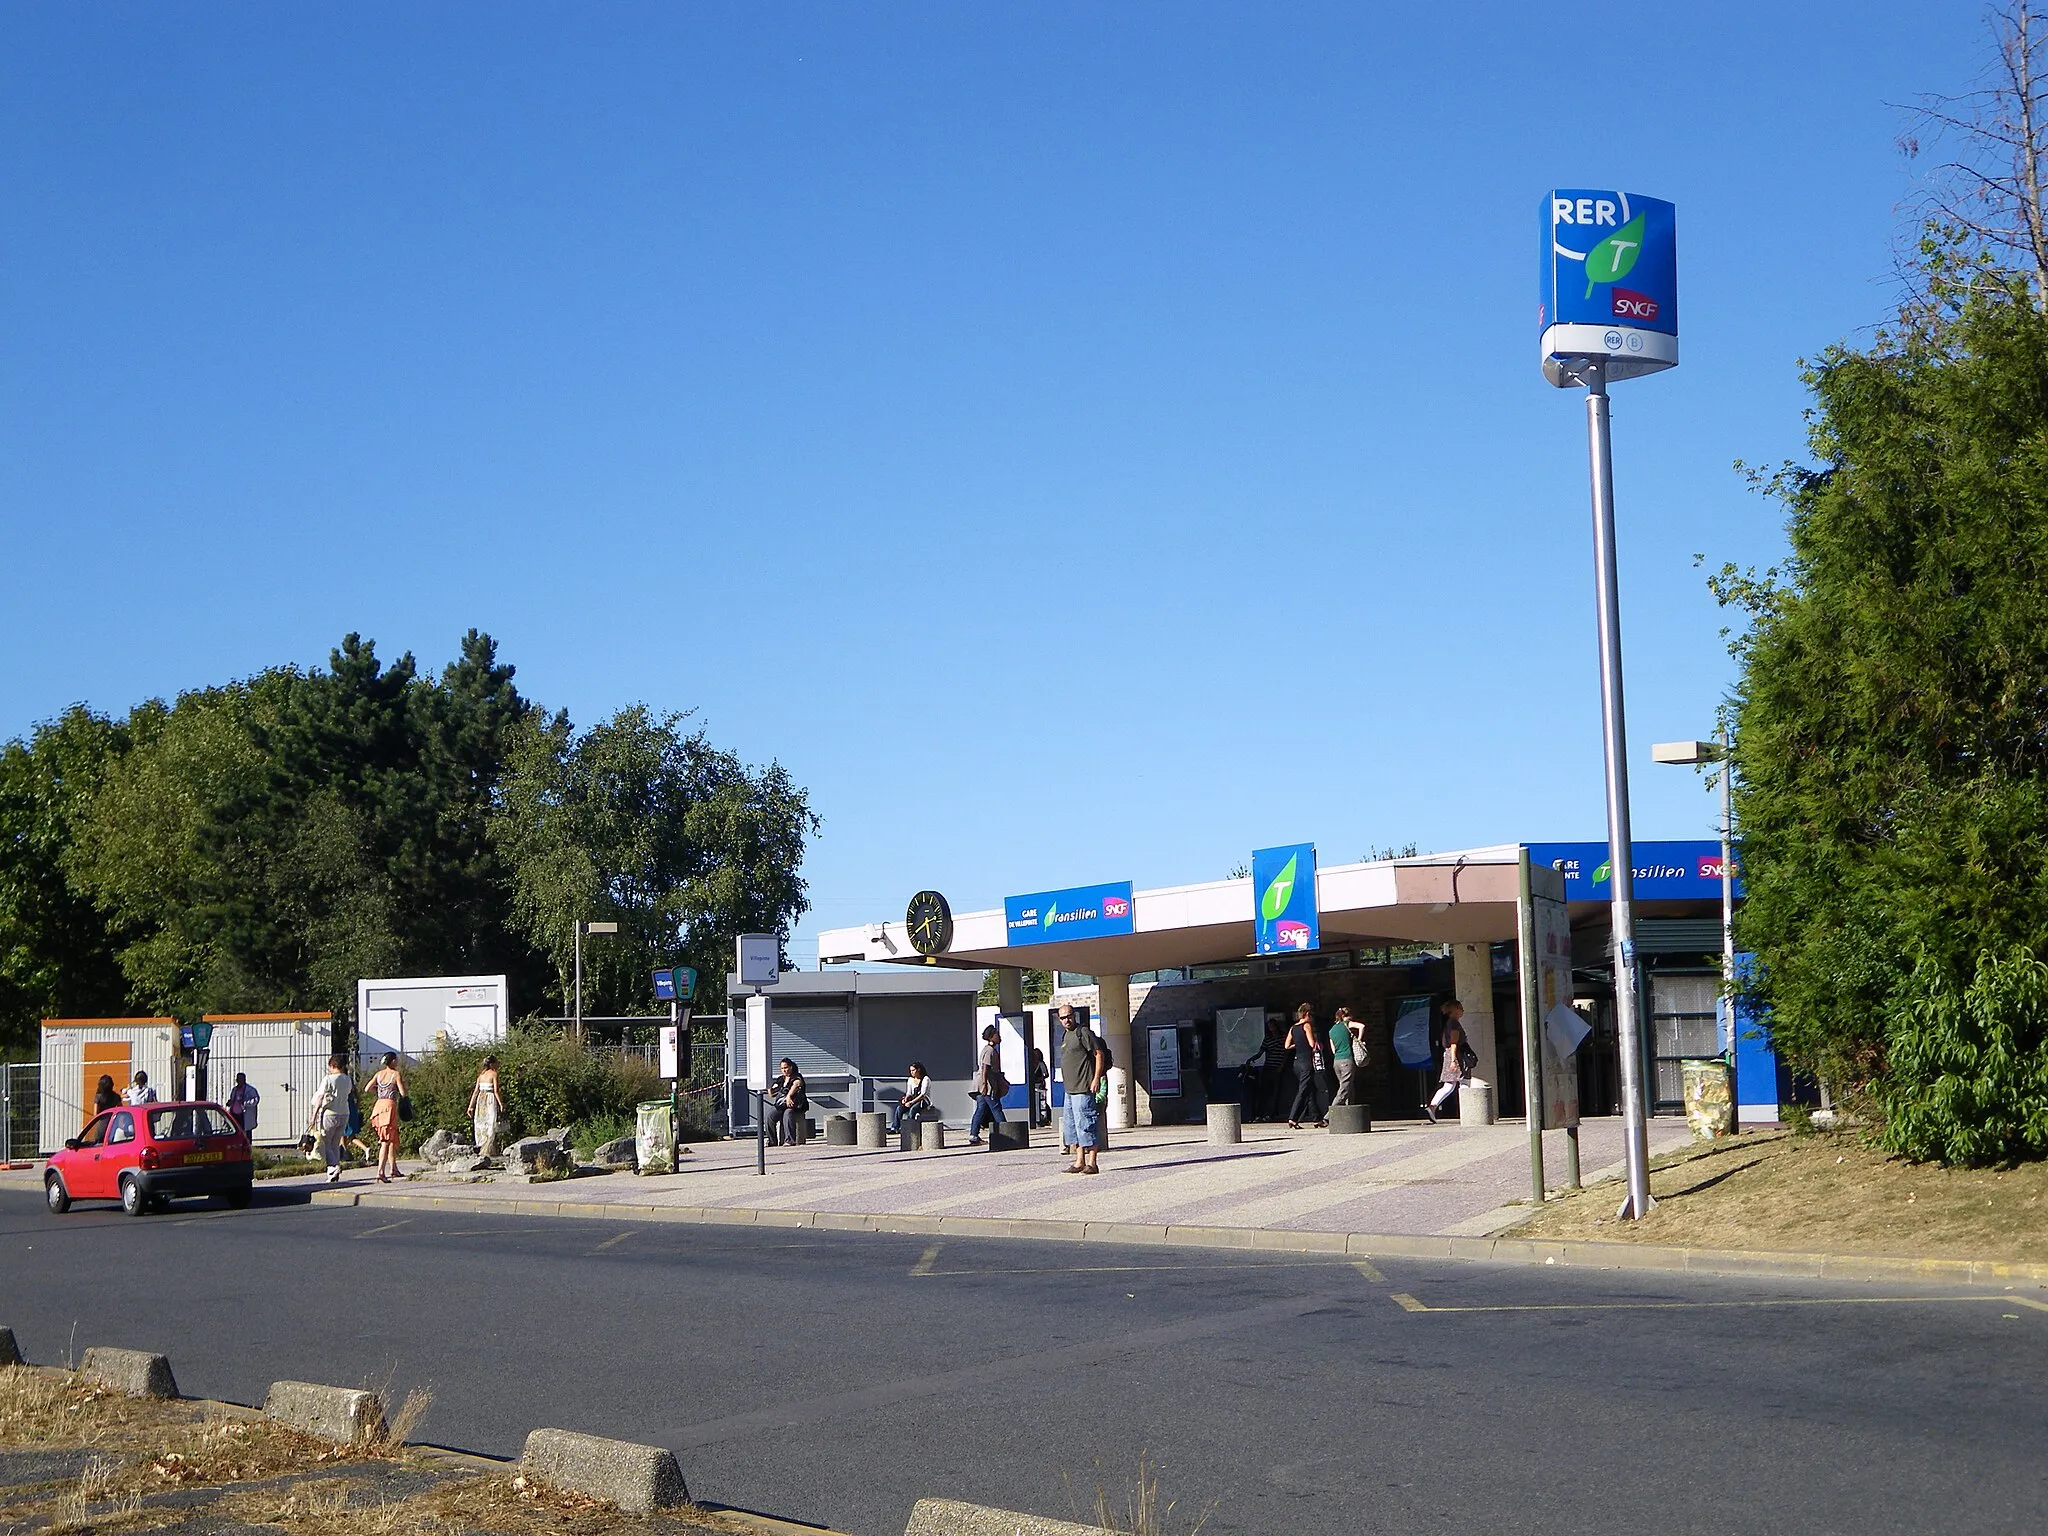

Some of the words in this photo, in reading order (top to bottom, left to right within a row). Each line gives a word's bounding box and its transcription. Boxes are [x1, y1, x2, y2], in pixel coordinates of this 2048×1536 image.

[1555, 198, 1617, 226] RER
[1610, 240, 1638, 272] T
[1614, 299, 1659, 316] SNCF
[1606, 336, 1621, 345] RER
[1631, 338, 1638, 347] B
[1273, 881, 1292, 911] T
[1021, 908, 1038, 918] GARE
[1047, 908, 1097, 923] Transilien
[1104, 903, 1128, 916] SNCF
